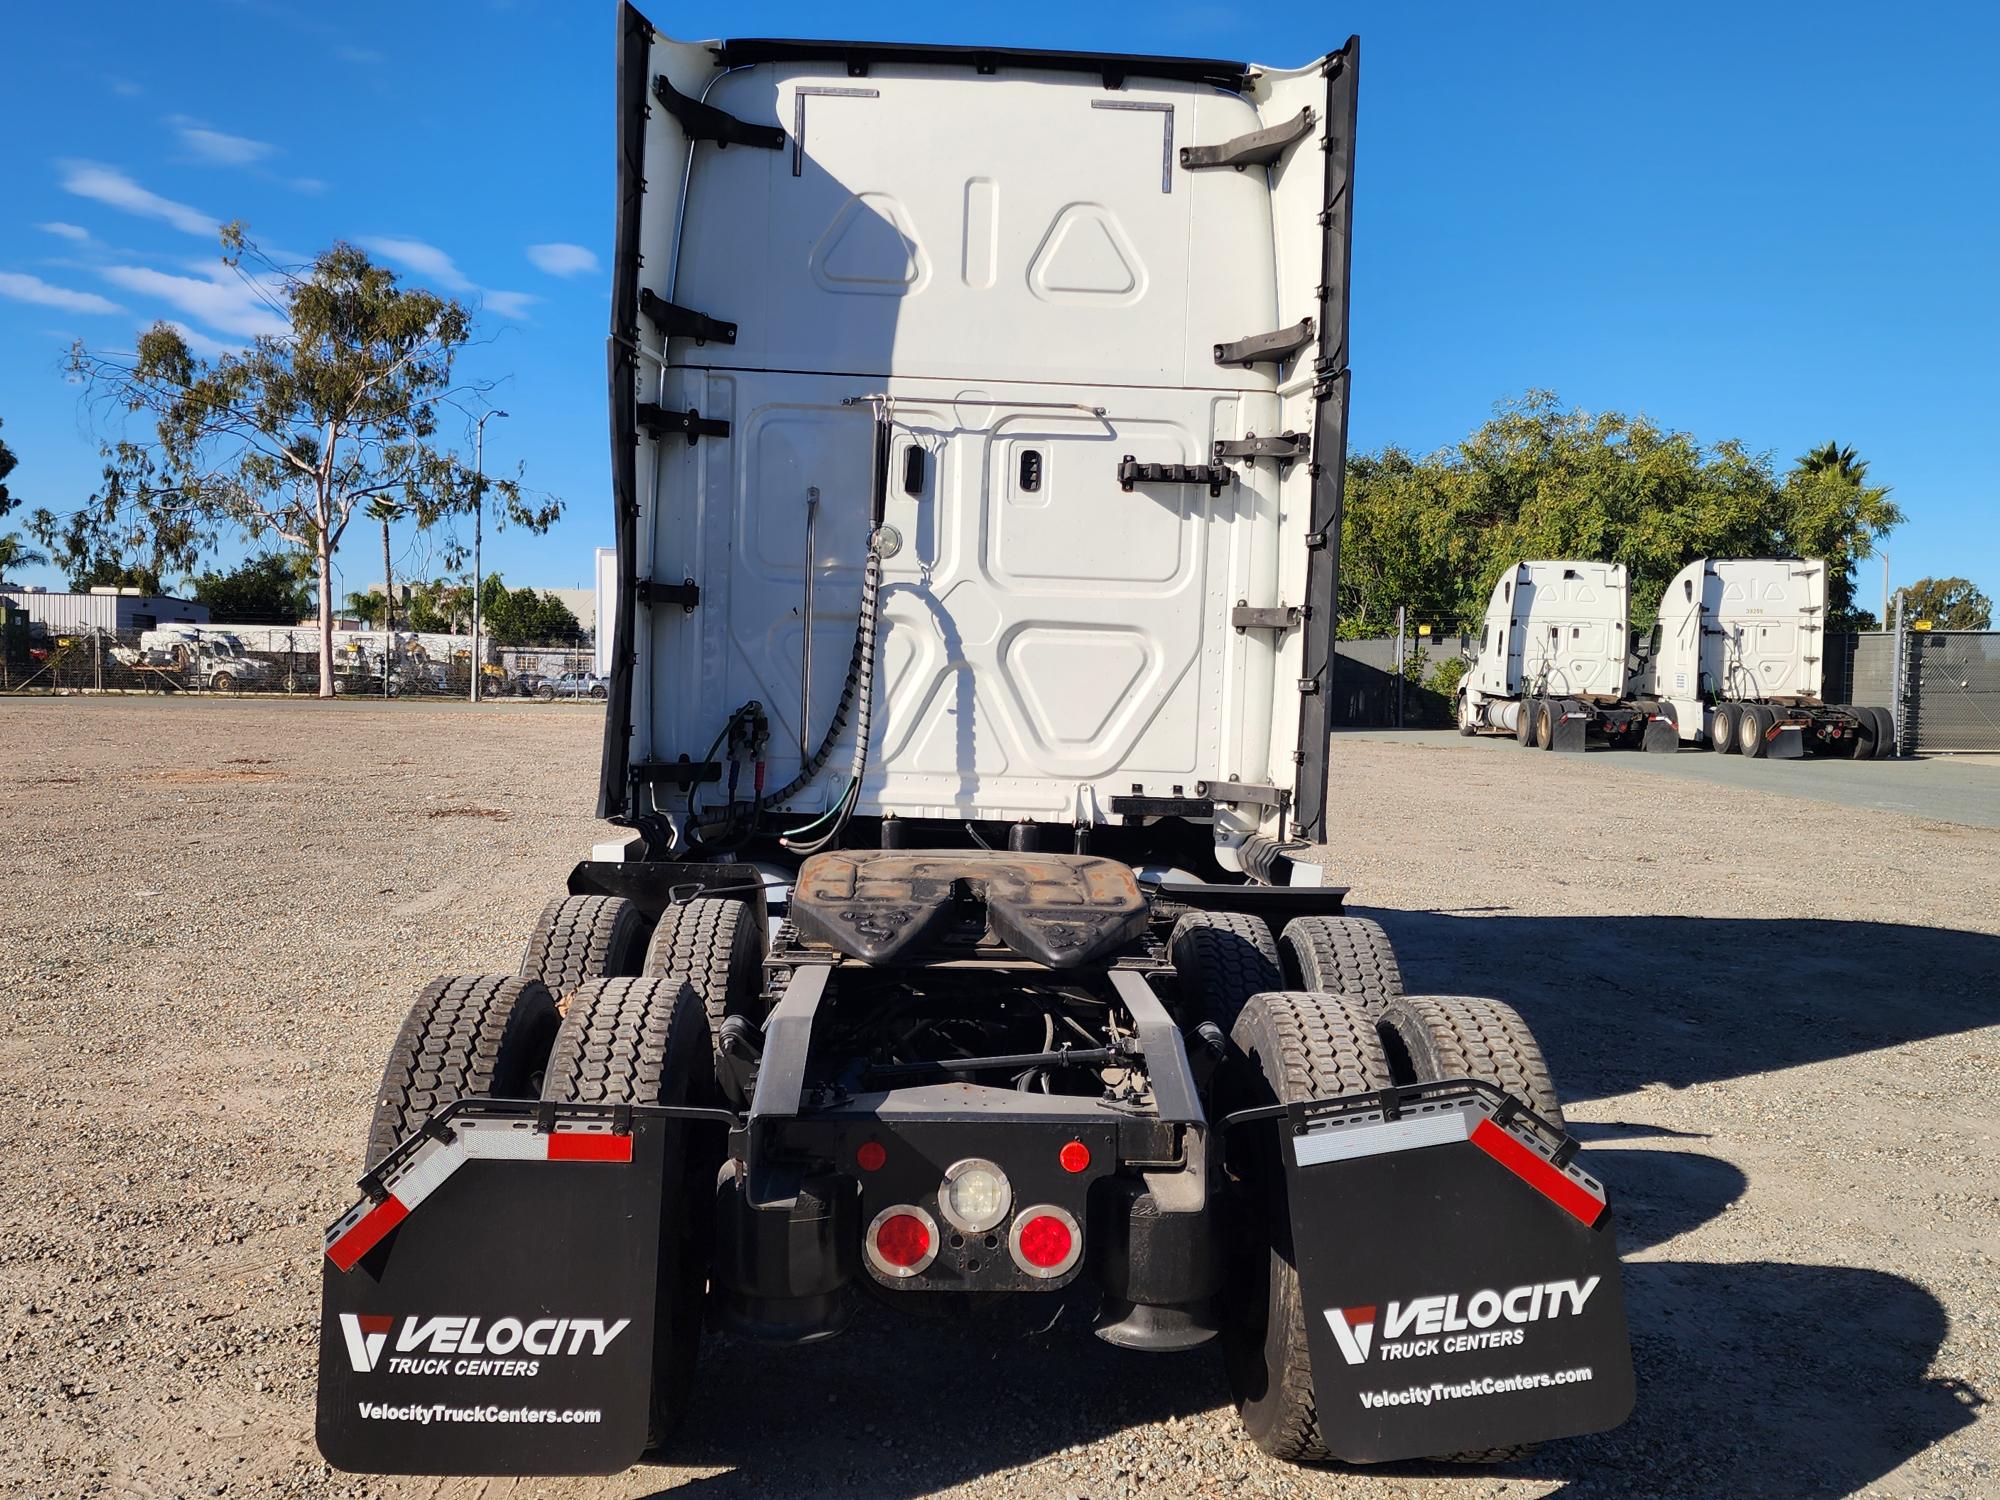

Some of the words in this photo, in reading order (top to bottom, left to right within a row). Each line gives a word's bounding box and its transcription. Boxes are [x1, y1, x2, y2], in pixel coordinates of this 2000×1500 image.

[1383, 1275, 1601, 1339] VELOCITY
[395, 1315, 632, 1356] VELOCITY
[1379, 1338, 1440, 1361] TRUCK
[1443, 1328, 1526, 1354] CENTERS
[387, 1357, 450, 1375] TRUCK
[454, 1359, 540, 1377] CENTERS
[1358, 1367, 1594, 1409] VelocityTruckCenters.com
[357, 1402, 603, 1425] VelocityTruckCenters.com
